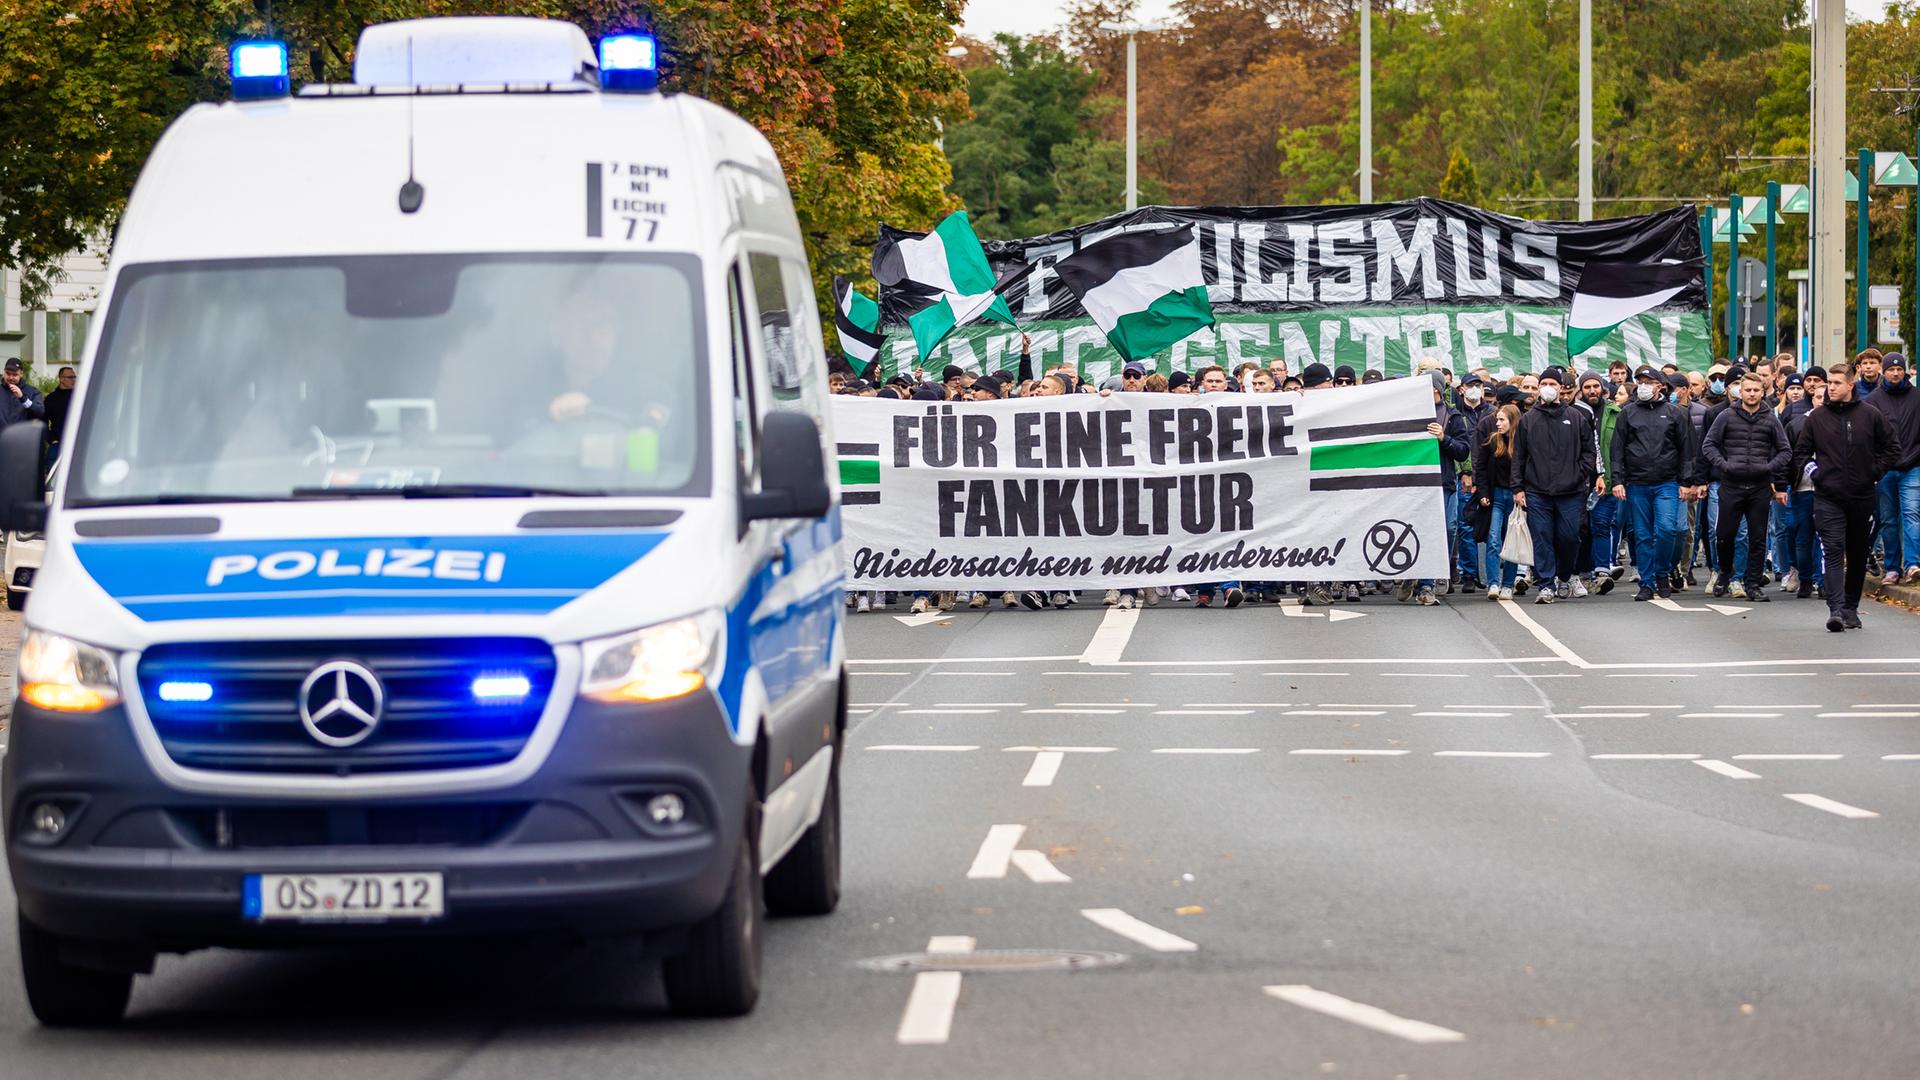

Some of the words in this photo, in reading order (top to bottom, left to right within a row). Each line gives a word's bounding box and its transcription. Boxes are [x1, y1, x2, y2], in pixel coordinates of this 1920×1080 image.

[629, 164, 668, 178] BPH
[631, 181, 649, 193] NI
[612, 198, 666, 214] EICHE
[621, 216, 658, 242] 77
[1023, 218, 1561, 313] PULISMUS
[893, 405, 997, 468] FÜR
[1014, 409, 1135, 468] EINE
[1148, 404, 1298, 465] FREIE
[938, 472, 1254, 538] FANKULTUR
[853, 546, 1093, 579] Niedersachsen
[1101, 545, 1170, 575] und
[1177, 537, 1346, 574] anderswo!
[1369, 523, 1415, 572] 96
[205, 548, 506, 587] POLIZEI
[277, 877, 319, 910] OS
[341, 877, 383, 909] ZD
[392, 877, 430, 909] 12
